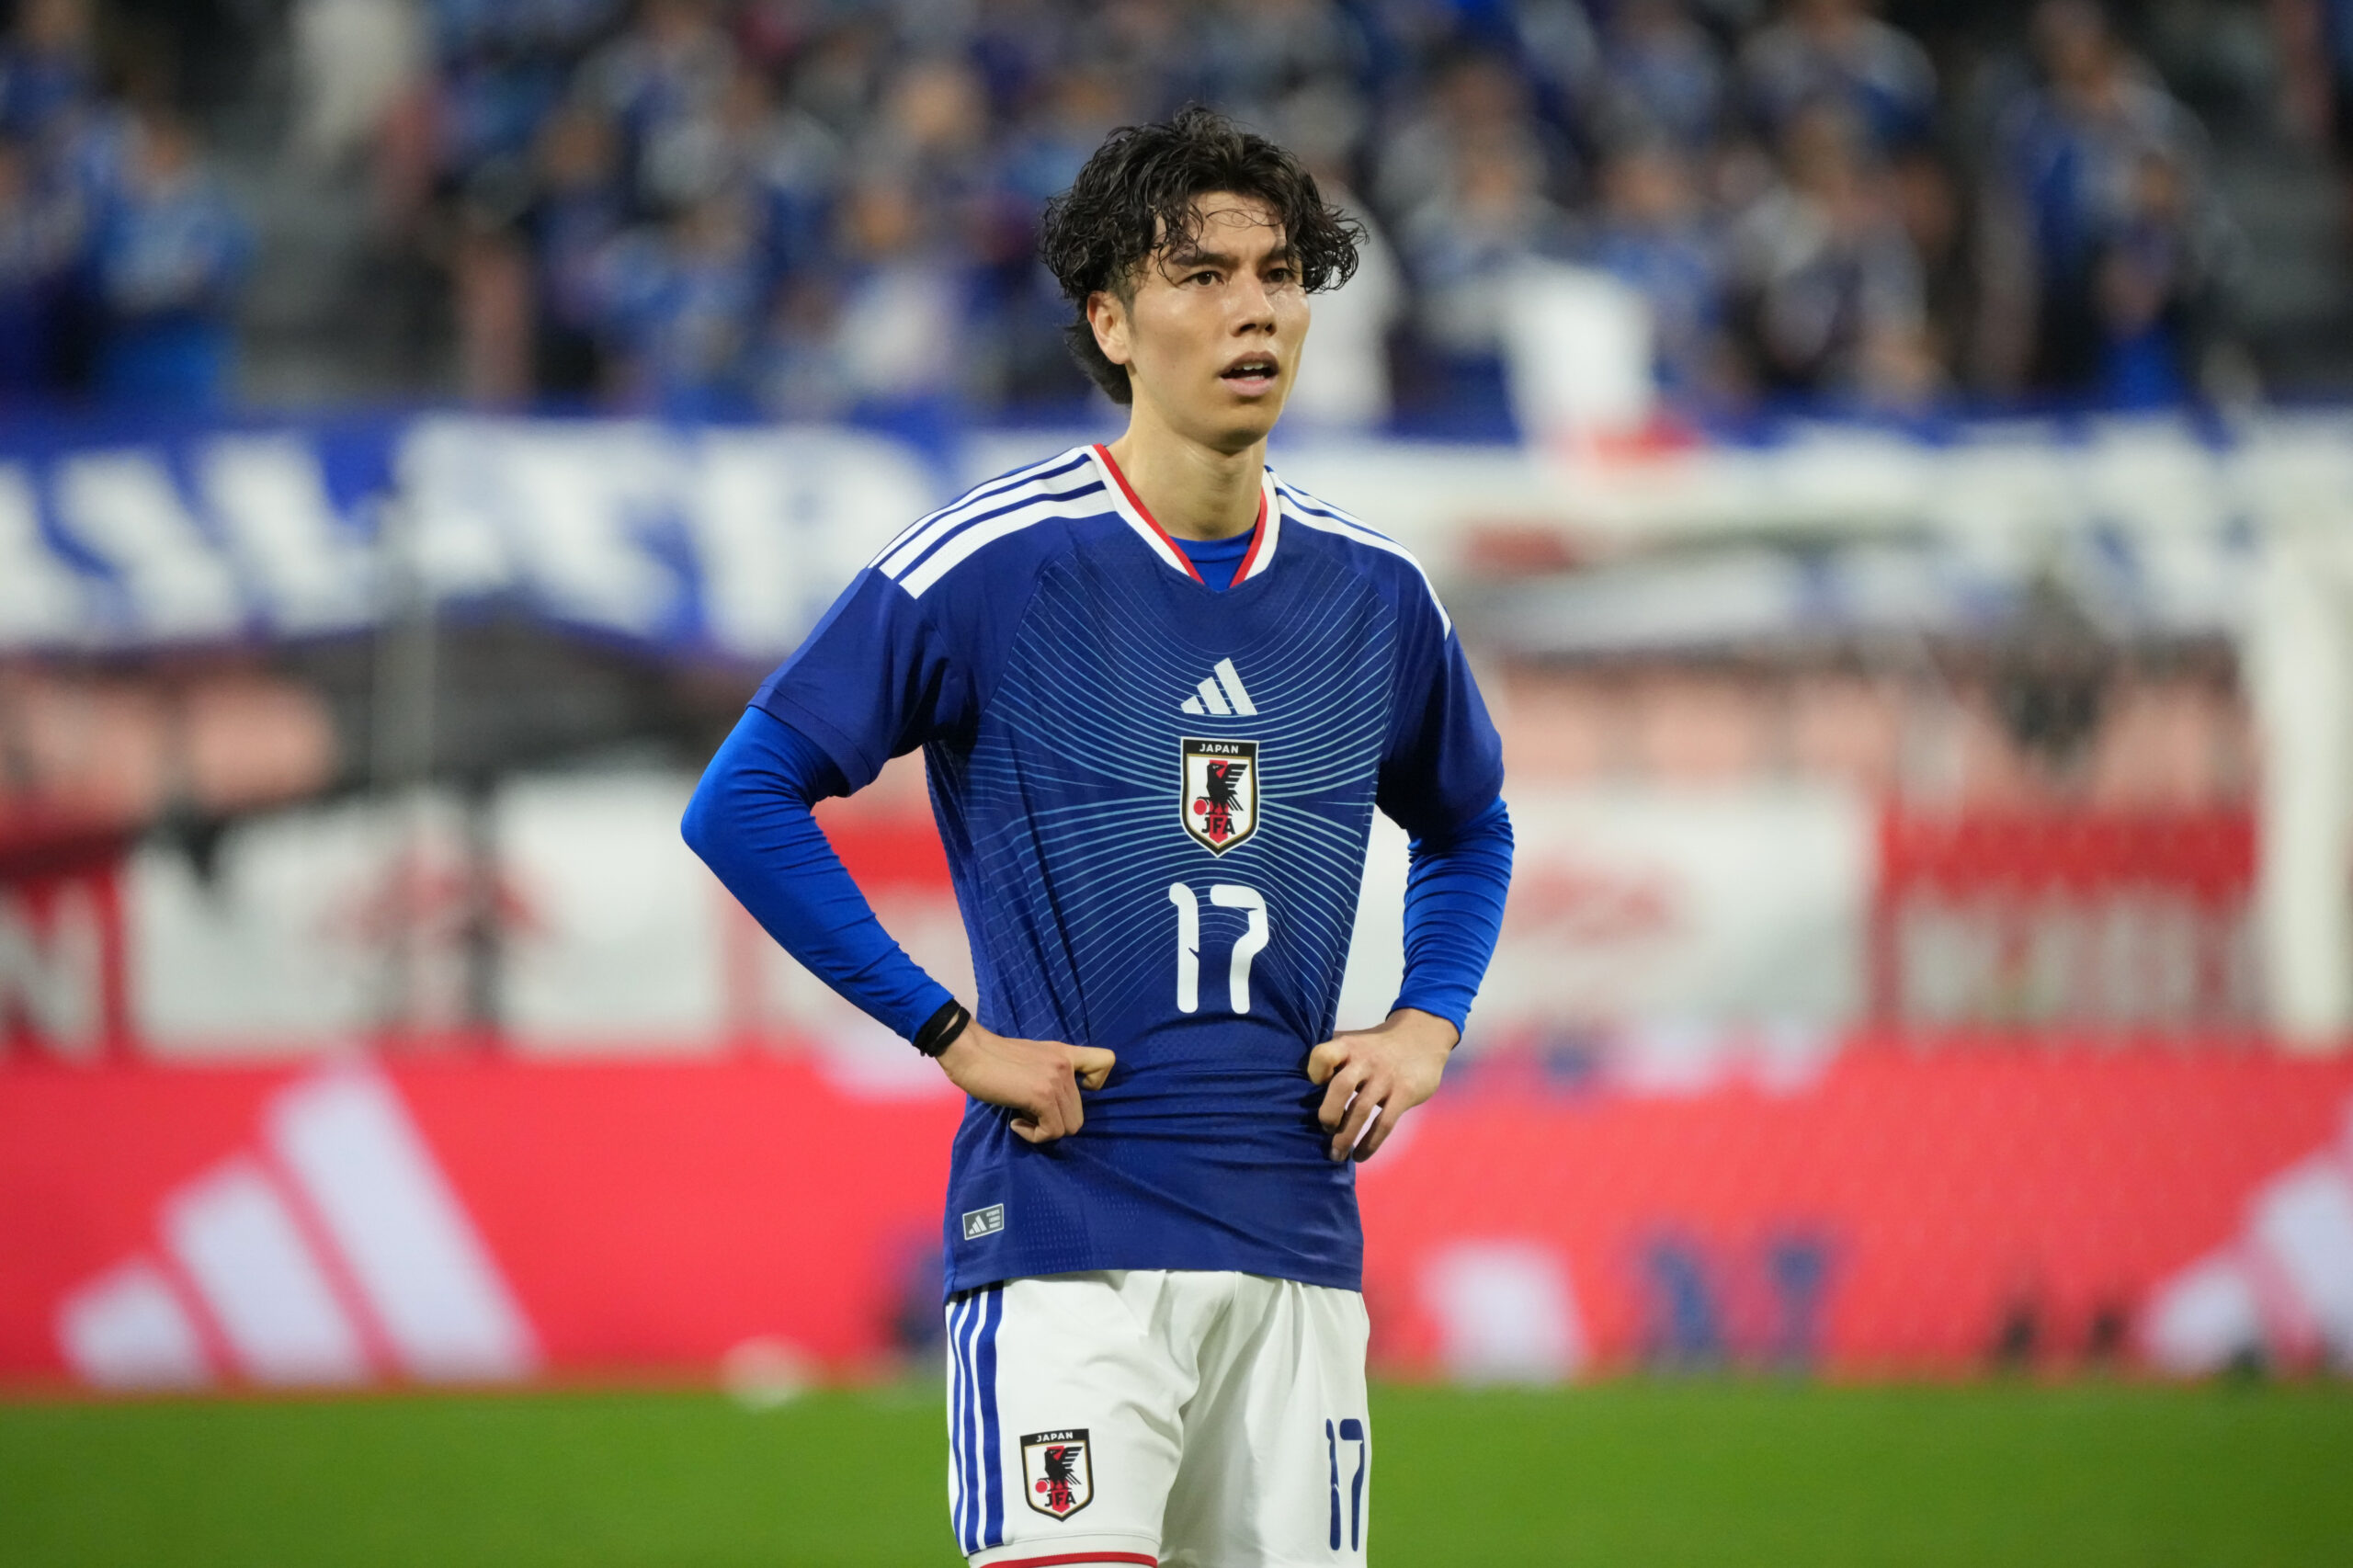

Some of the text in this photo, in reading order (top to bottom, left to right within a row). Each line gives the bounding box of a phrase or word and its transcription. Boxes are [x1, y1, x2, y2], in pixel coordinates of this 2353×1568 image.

[1199, 743, 1239, 755] JAPAN
[1201, 817, 1236, 835] JFA
[1169, 882, 1269, 1015] 17
[1036, 1431, 1074, 1443] JAPAN
[1326, 1418, 1365, 1552] 17
[1044, 1491, 1076, 1507] JFA
